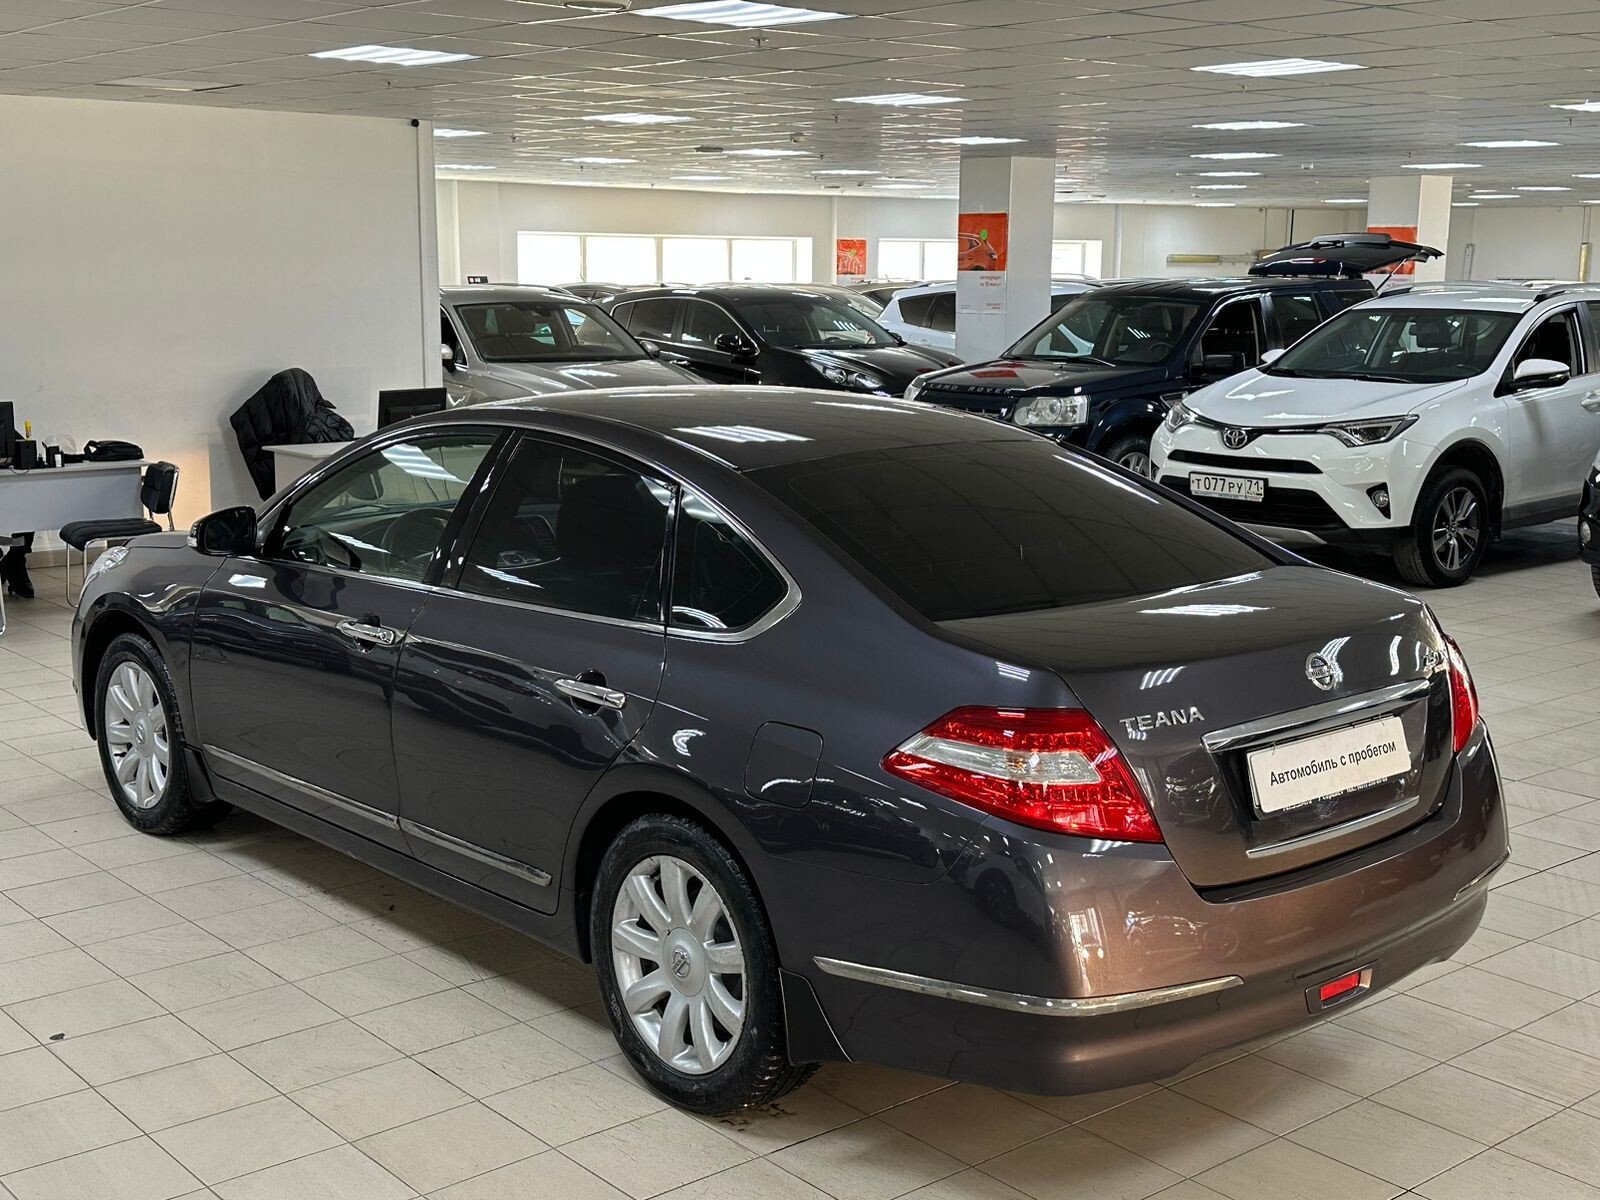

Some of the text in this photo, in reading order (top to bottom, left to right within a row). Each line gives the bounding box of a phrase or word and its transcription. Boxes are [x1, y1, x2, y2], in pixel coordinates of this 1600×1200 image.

[929, 383, 1010, 395] LAND ROVER
[1119, 705, 1205, 732] TEANA
[1270, 741, 1397, 786] Автомобиль с пробегом
